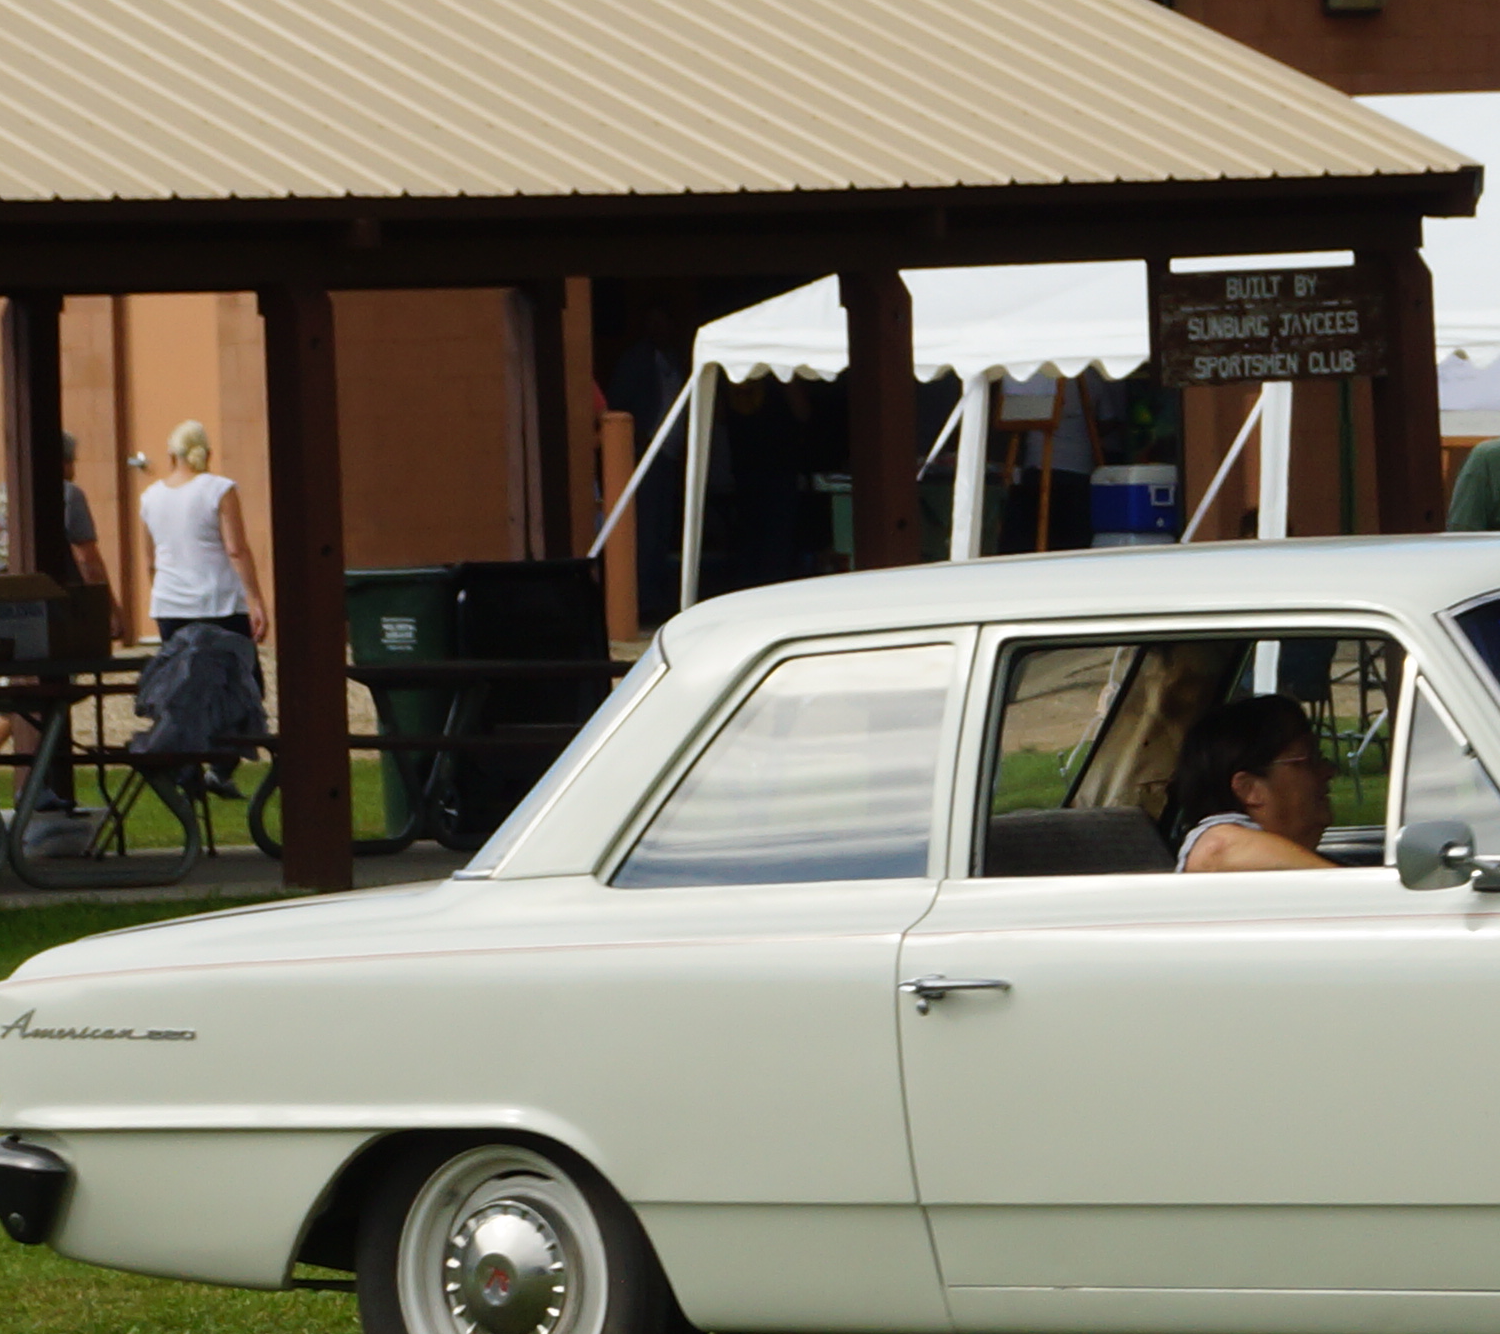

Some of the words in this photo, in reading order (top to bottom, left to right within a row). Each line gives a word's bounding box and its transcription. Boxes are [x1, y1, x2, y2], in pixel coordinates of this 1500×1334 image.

[1226, 275, 1283, 300] BUILT
[1294, 273, 1318, 297] BY
[1187, 315, 1270, 341] SUNBURG
[1278, 311, 1360, 337] JAYCEES
[1193, 354, 1299, 379] SPORTSMEN
[1307, 349, 1356, 374] CLUB
[0, 1008, 143, 1041] American
